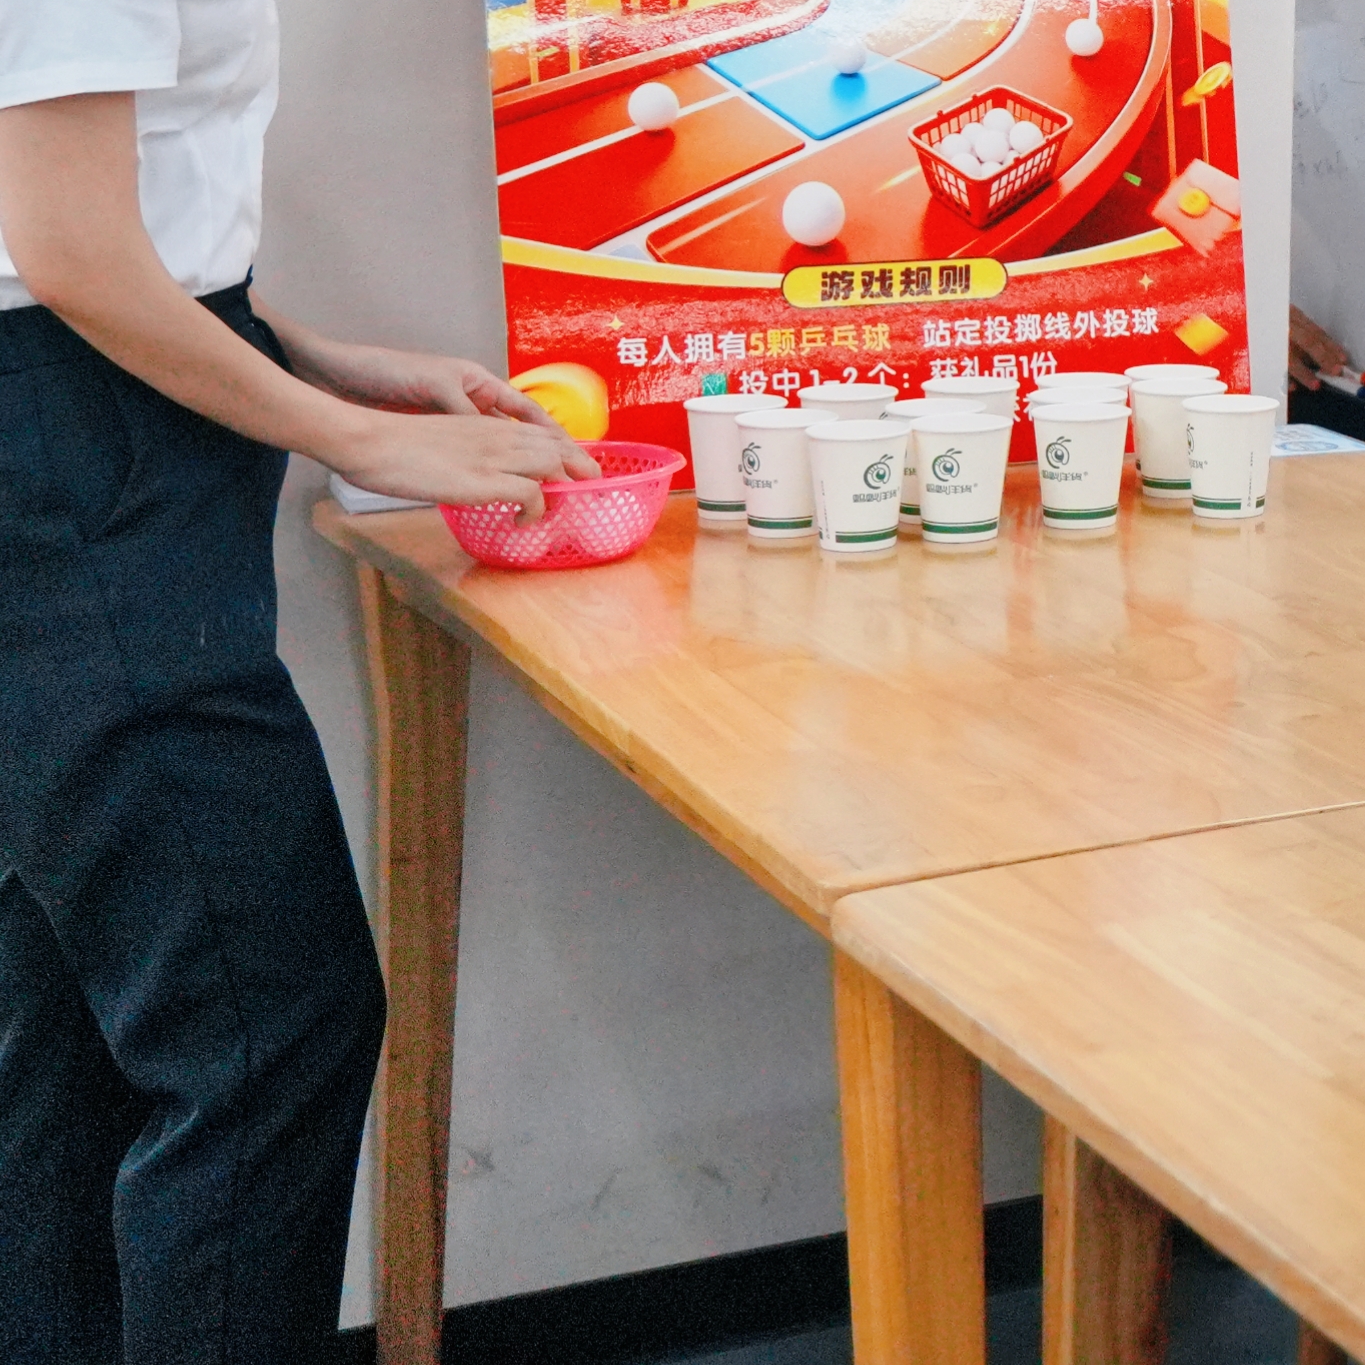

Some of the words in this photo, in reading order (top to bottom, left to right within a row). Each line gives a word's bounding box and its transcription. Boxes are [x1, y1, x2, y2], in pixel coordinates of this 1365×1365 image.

[820, 263, 971, 302] 游戏规则
[616, 322, 891, 367] 每人拥有5颗乒乓球
[922, 306, 1160, 348] 站定投掷线外投球
